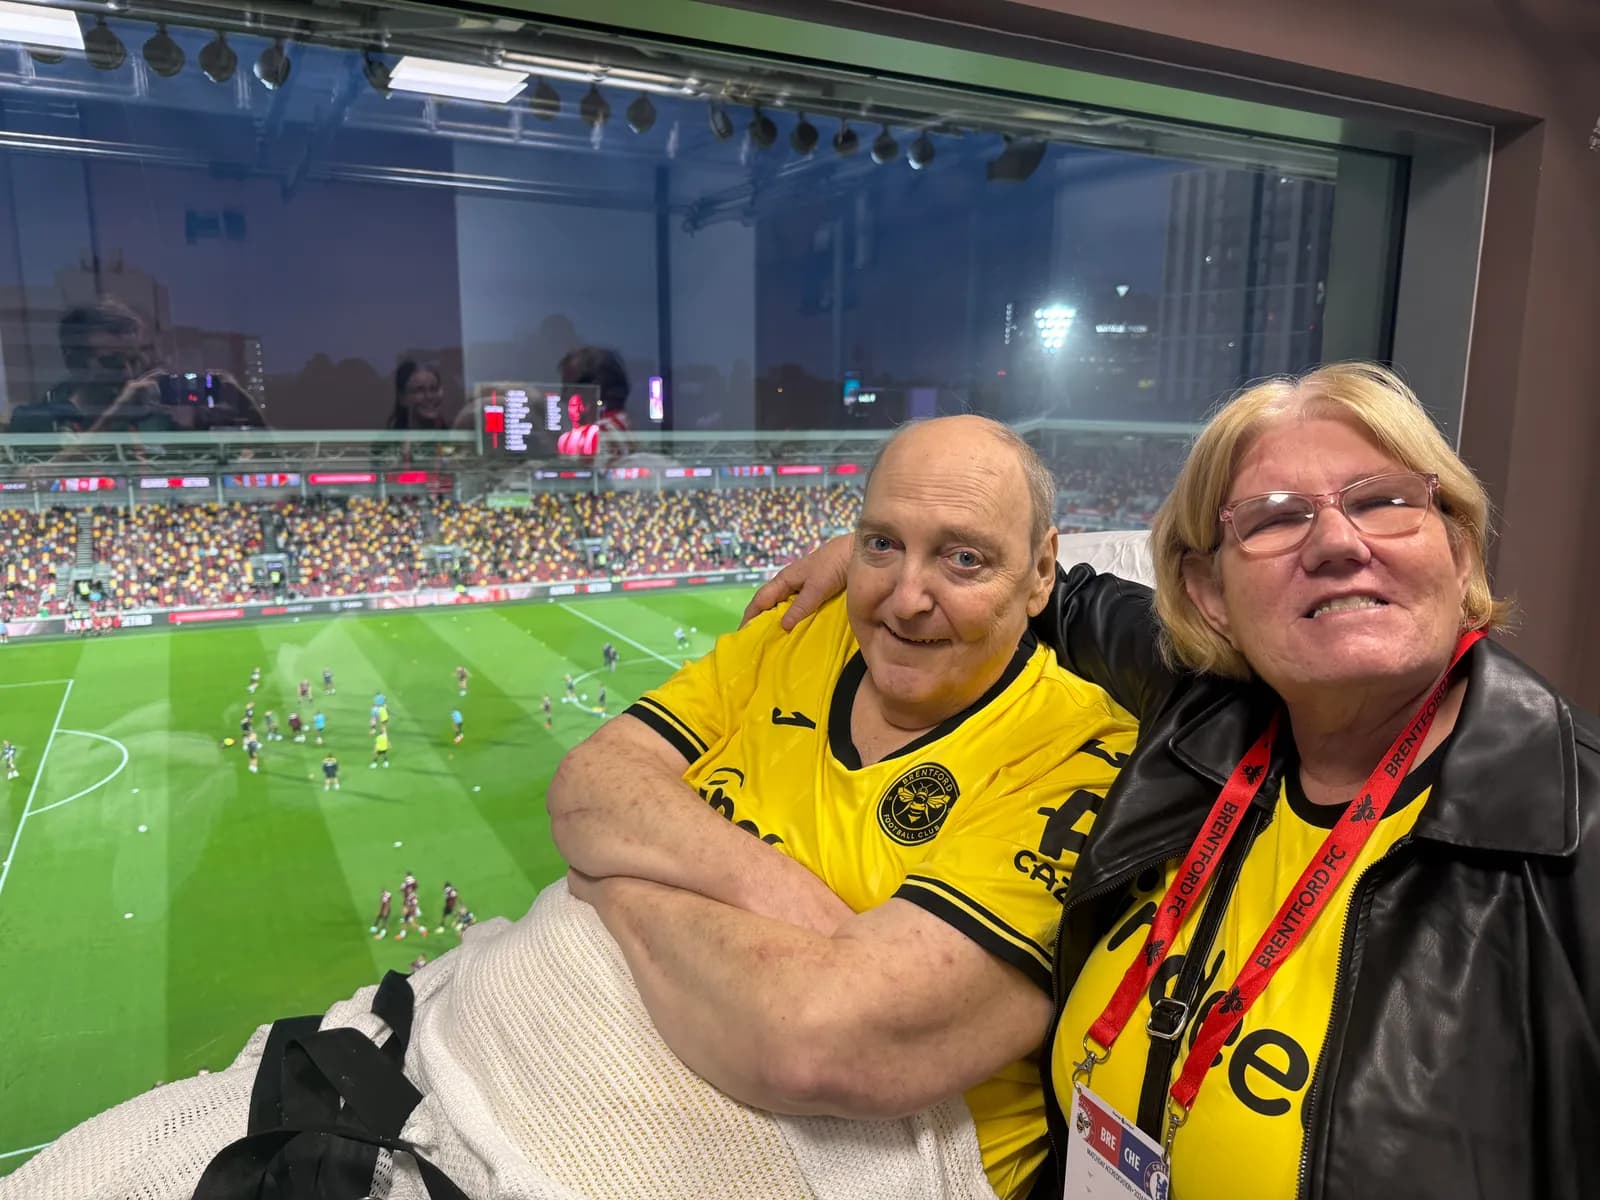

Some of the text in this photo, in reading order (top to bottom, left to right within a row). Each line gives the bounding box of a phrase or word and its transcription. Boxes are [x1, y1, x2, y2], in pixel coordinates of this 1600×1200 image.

[902, 768, 953, 792] BRENTFORD
[883, 814, 940, 840] FOOTBALL CLUB
[1166, 800, 1239, 918] BRENTFORD FC
[1255, 844, 1347, 969] BRENTFORD FC
[1100, 1127, 1117, 1151] BRE
[1124, 1147, 1142, 1172] CHE
